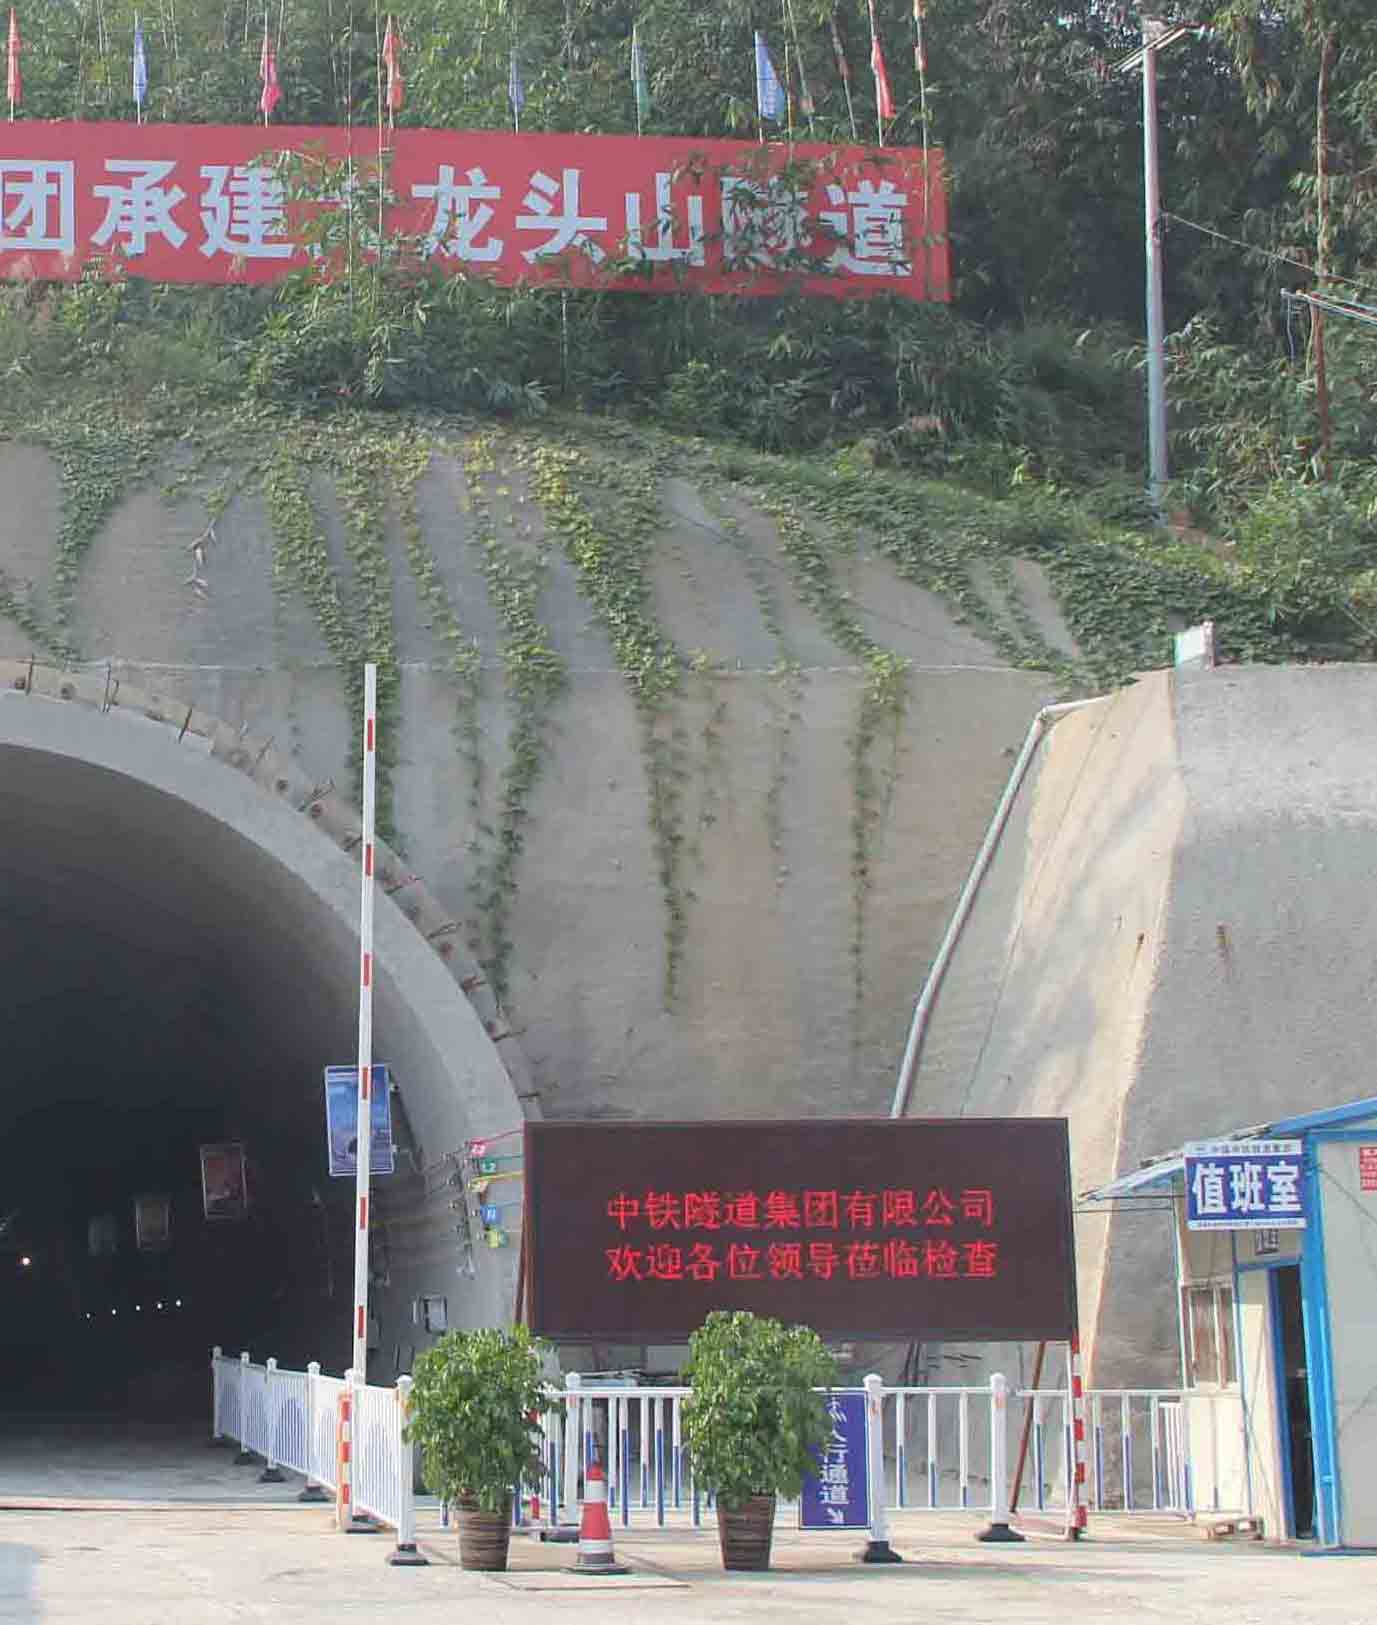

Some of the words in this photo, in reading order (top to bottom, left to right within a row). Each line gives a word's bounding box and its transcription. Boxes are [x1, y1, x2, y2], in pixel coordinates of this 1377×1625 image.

[1191, 1160, 1303, 1215] 值班室
[607, 1190, 993, 1231] 中铁隧道集团有限公司
[605, 1241, 998, 1281] 欢迎各位领导莅临检查
